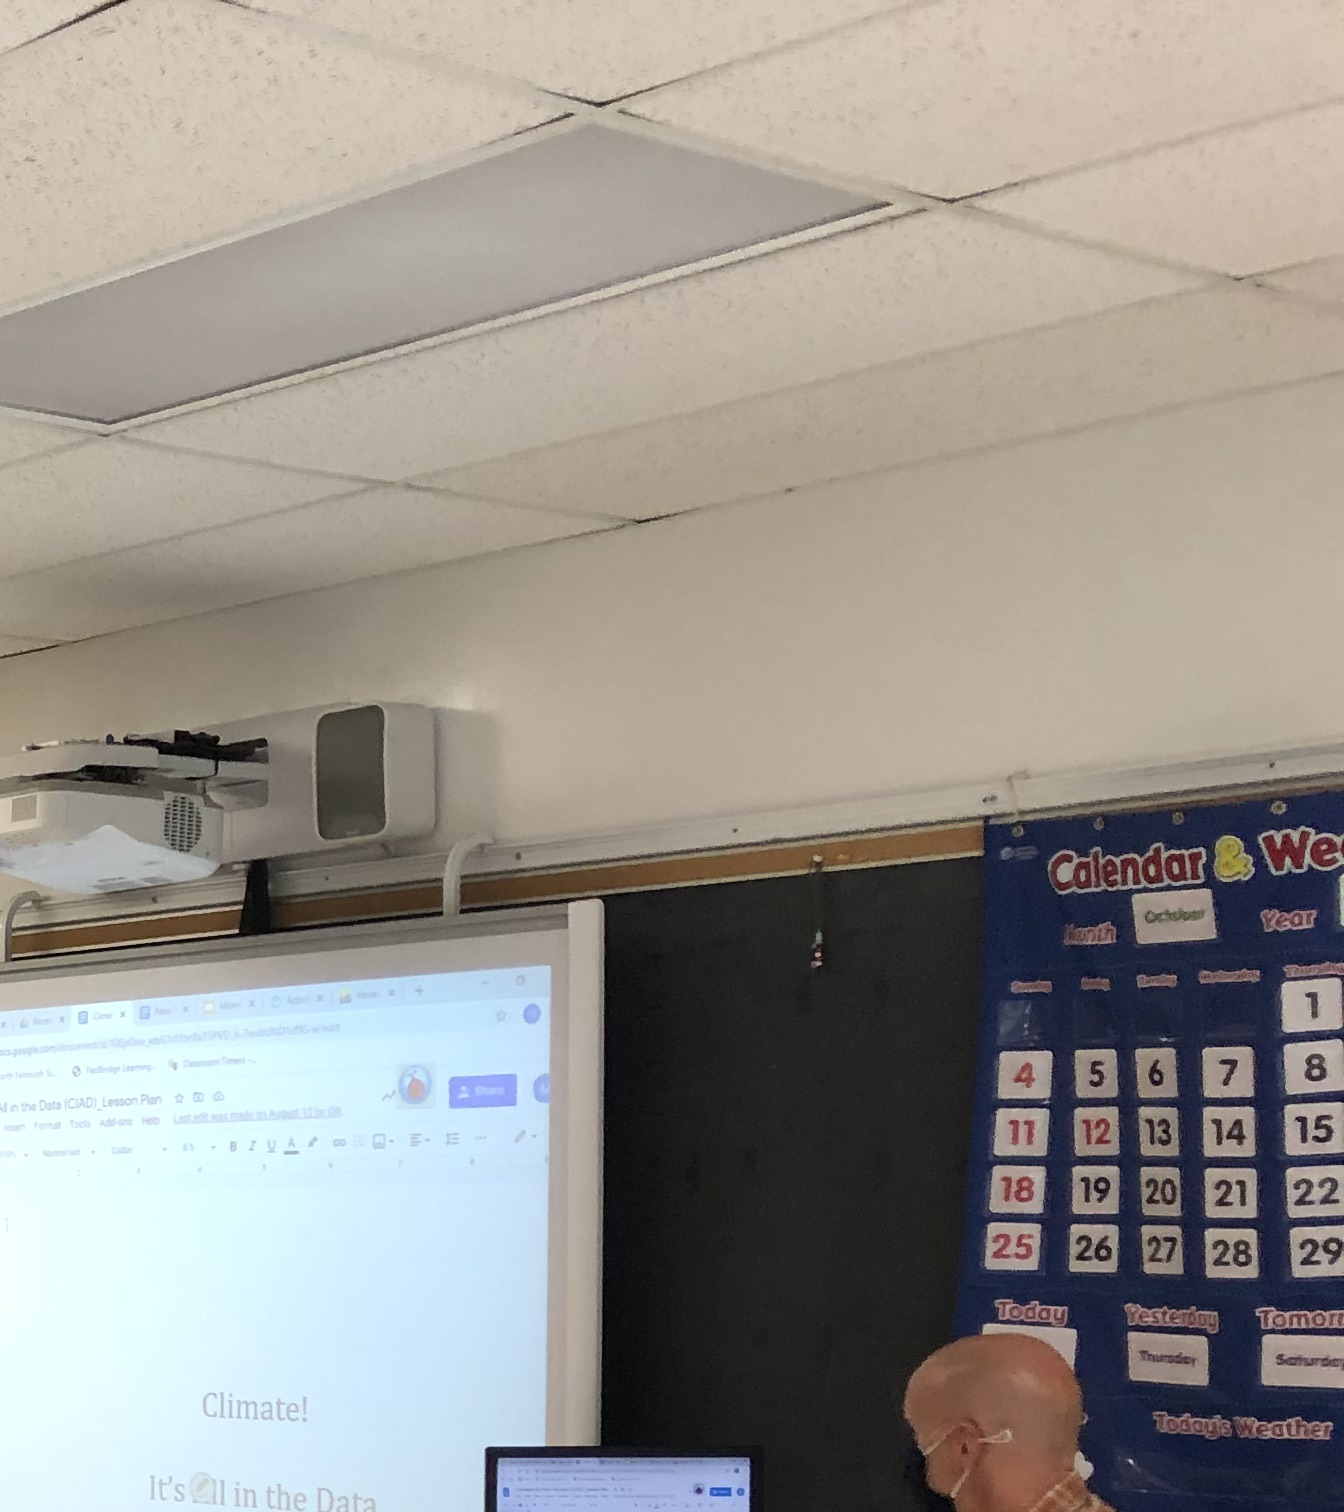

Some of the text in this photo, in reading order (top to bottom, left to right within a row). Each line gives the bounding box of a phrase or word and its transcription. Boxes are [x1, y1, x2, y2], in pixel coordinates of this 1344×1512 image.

[1049, 829, 1344, 893] Calendar & We
[1262, 909, 1317, 932] Year
[1305, 991, 1318, 1020] 1
[1014, 1054, 1327, 1088] 4 5 6 7 8
[10, 1102, 20, 1113] in
[21, 1101, 37, 1113] the
[39, 1099, 62, 1112] Data
[141, 1093, 162, 1106] Plan
[173, 1112, 191, 1124] Last
[269, 1107, 299, 1121] August
[301, 1107, 314, 1118] 12
[4, 1122, 26, 1133] Insert
[34, 1121, 62, 1131] Format
[69, 1119, 91, 1130] Tools
[99, 1117, 133, 1128] Add-ons
[141, 1115, 161, 1127] Help
[1009, 1116, 1334, 1146] 11 12 13 14 15
[1001, 1175, 1339, 1207] 18 19 20 21 22
[992, 1233, 1344, 1268] 25 26 27 28 29
[995, 1299, 1069, 1326] Today
[1124, 1303, 1219, 1333] Yesterday
[1138, 1350, 1199, 1367] Thursday
[202, 1392, 308, 1423] Climate!
[1152, 1411, 1334, 1440] Today's Weather
[150, 1474, 186, 1502] It's
[191, 1478, 226, 1506] ll
[234, 1481, 258, 1508] in
[266, 1483, 307, 1512] the
